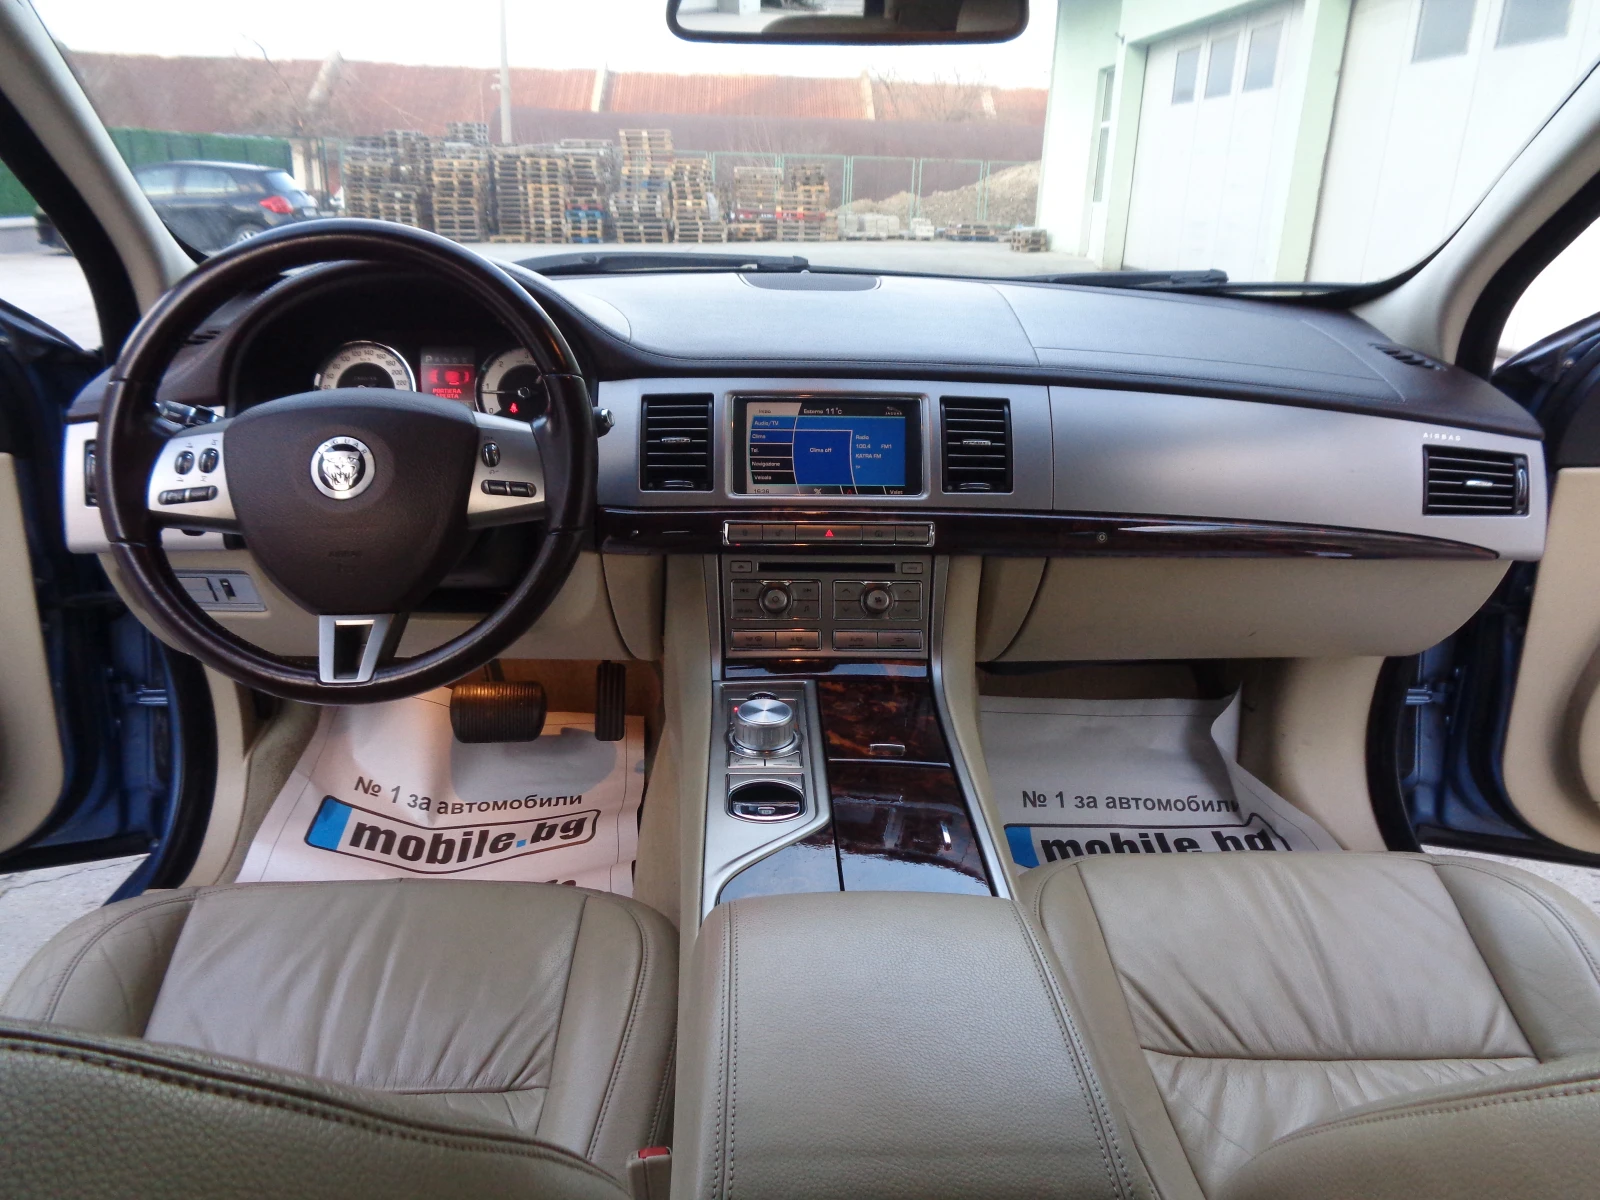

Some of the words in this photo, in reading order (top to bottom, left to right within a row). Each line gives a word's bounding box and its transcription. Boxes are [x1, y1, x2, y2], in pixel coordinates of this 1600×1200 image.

[1423, 432, 1461, 441] AIRBAG
[390, 785, 400, 804] 1
[407, 793, 432, 812] за
[436, 794, 582, 814] автомобили
[1055, 790, 1065, 808] 1
[1074, 794, 1098, 809] за
[349, 815, 588, 865] mobile.bg
